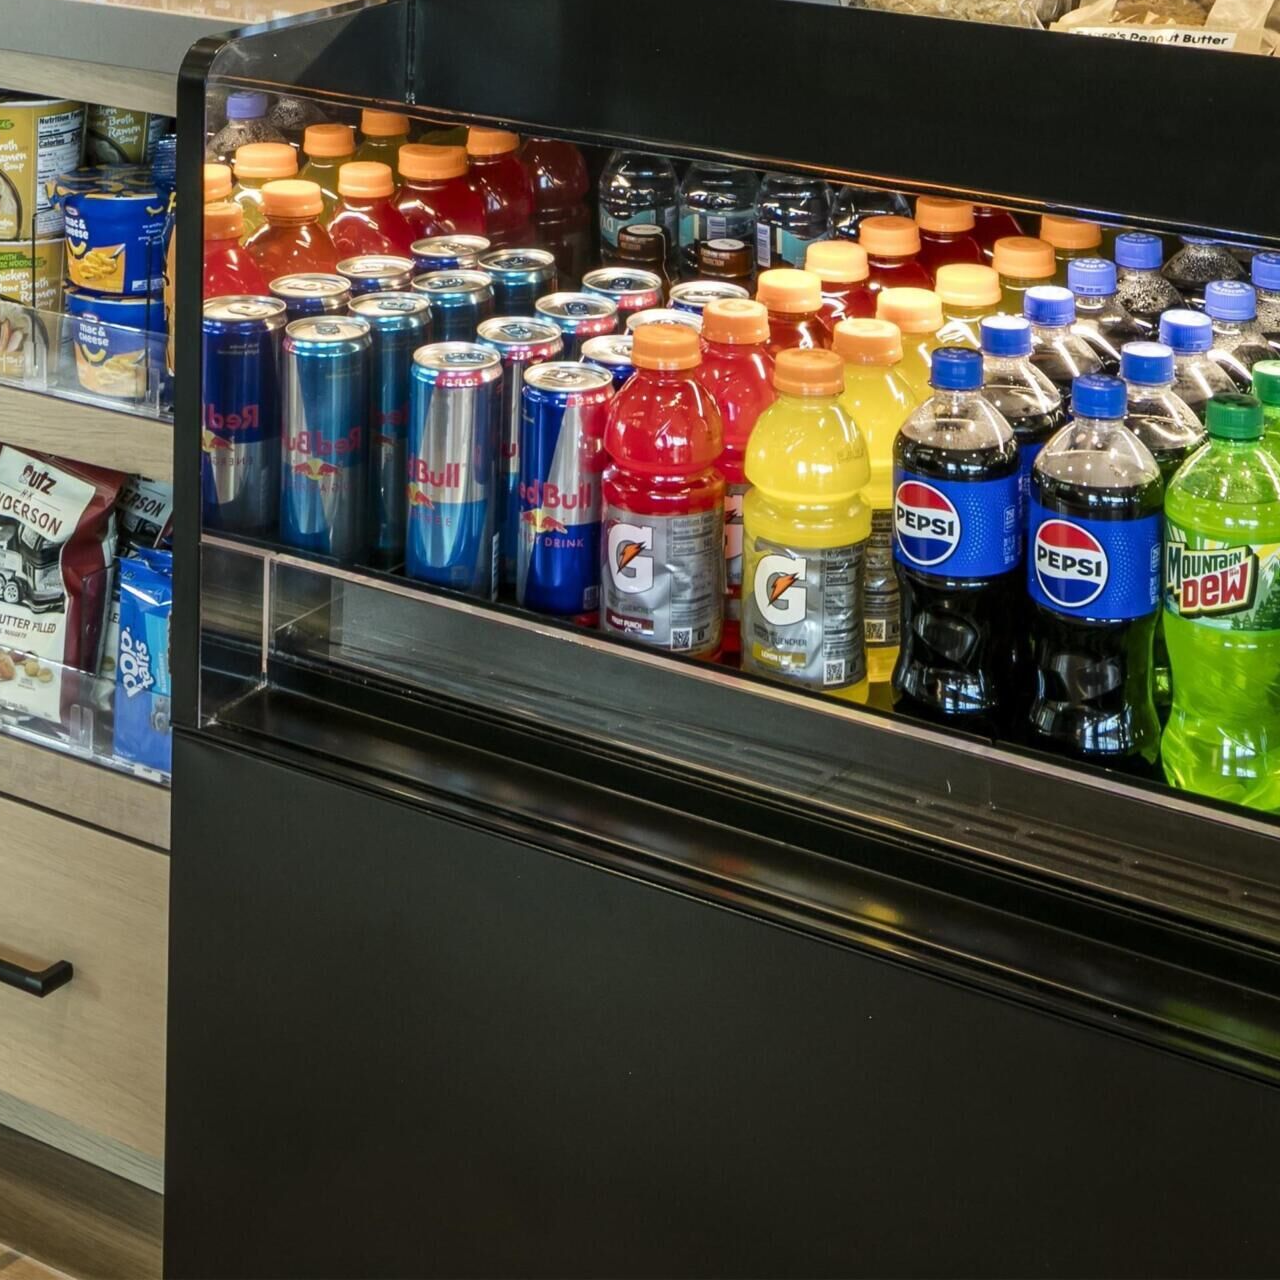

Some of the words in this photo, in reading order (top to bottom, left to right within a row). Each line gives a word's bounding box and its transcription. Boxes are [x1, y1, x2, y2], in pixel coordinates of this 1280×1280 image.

[1183, 34, 1229, 46] Butter
[108, 113, 134, 126] Broth
[108, 124, 141, 137] Ramen
[78, 332, 109, 347] cheese
[80, 323, 97, 334] mac
[98, 326, 106, 337] &
[416, 458, 461, 489] Bull
[120, 488, 166, 518] ERSON
[543, 481, 592, 511] Bull
[896, 505, 956, 538] PEPSI
[544, 537, 585, 549] DRINK
[608, 523, 655, 594] G
[1037, 544, 1103, 578] PEPSI
[754, 554, 808, 626] G
[32, 620, 58, 634] FILLED
